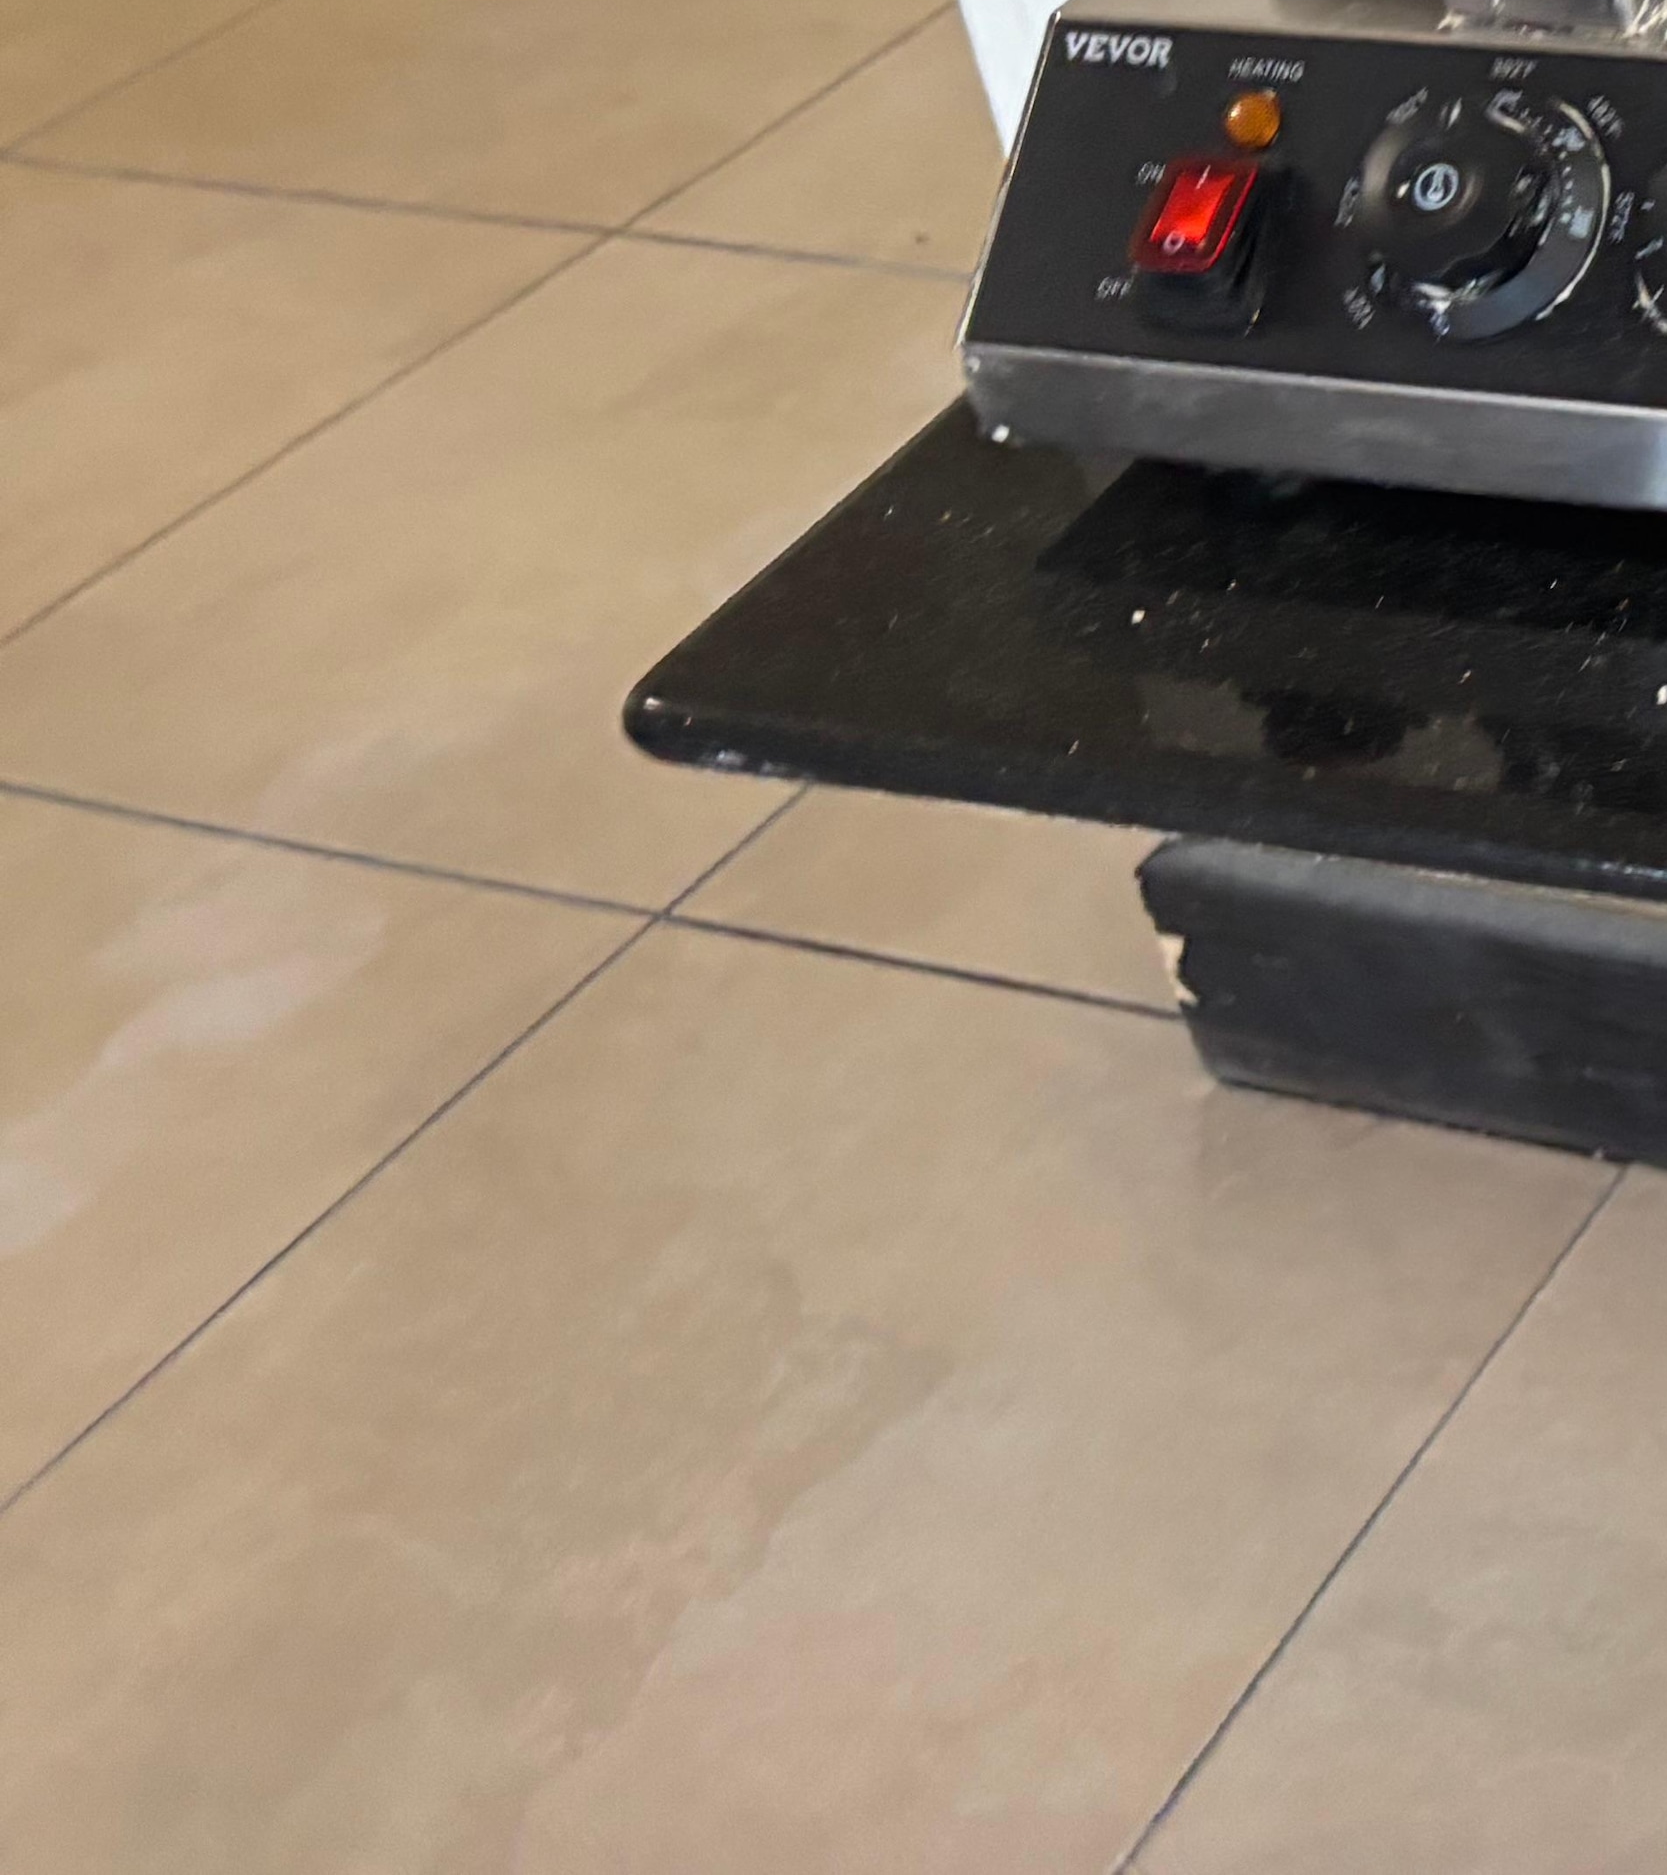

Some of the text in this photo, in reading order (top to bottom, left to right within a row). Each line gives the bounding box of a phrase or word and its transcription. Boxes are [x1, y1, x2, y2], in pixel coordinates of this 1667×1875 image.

[1065, 31, 1174, 69] VEVOR
[1228, 57, 1306, 82] HEATING
[1136, 162, 1166, 185] ON
